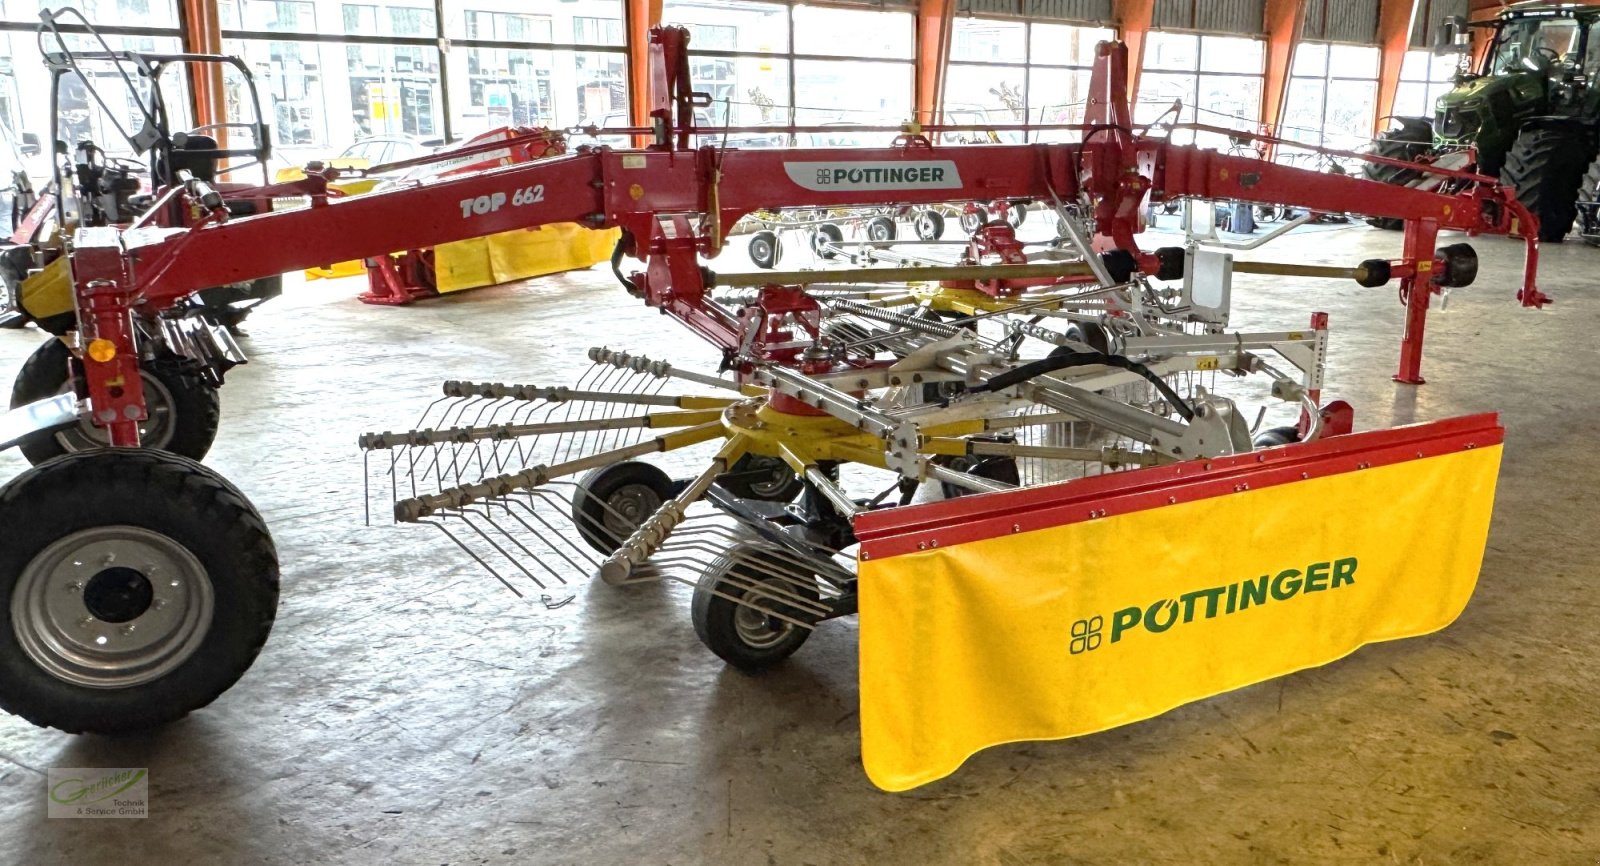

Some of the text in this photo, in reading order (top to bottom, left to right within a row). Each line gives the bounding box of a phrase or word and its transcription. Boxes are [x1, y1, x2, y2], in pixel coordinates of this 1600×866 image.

[834, 167, 945, 184] PÖTTINGER
[460, 184, 545, 219] TOP 662
[1110, 556, 1358, 644] PÖTTINGER
